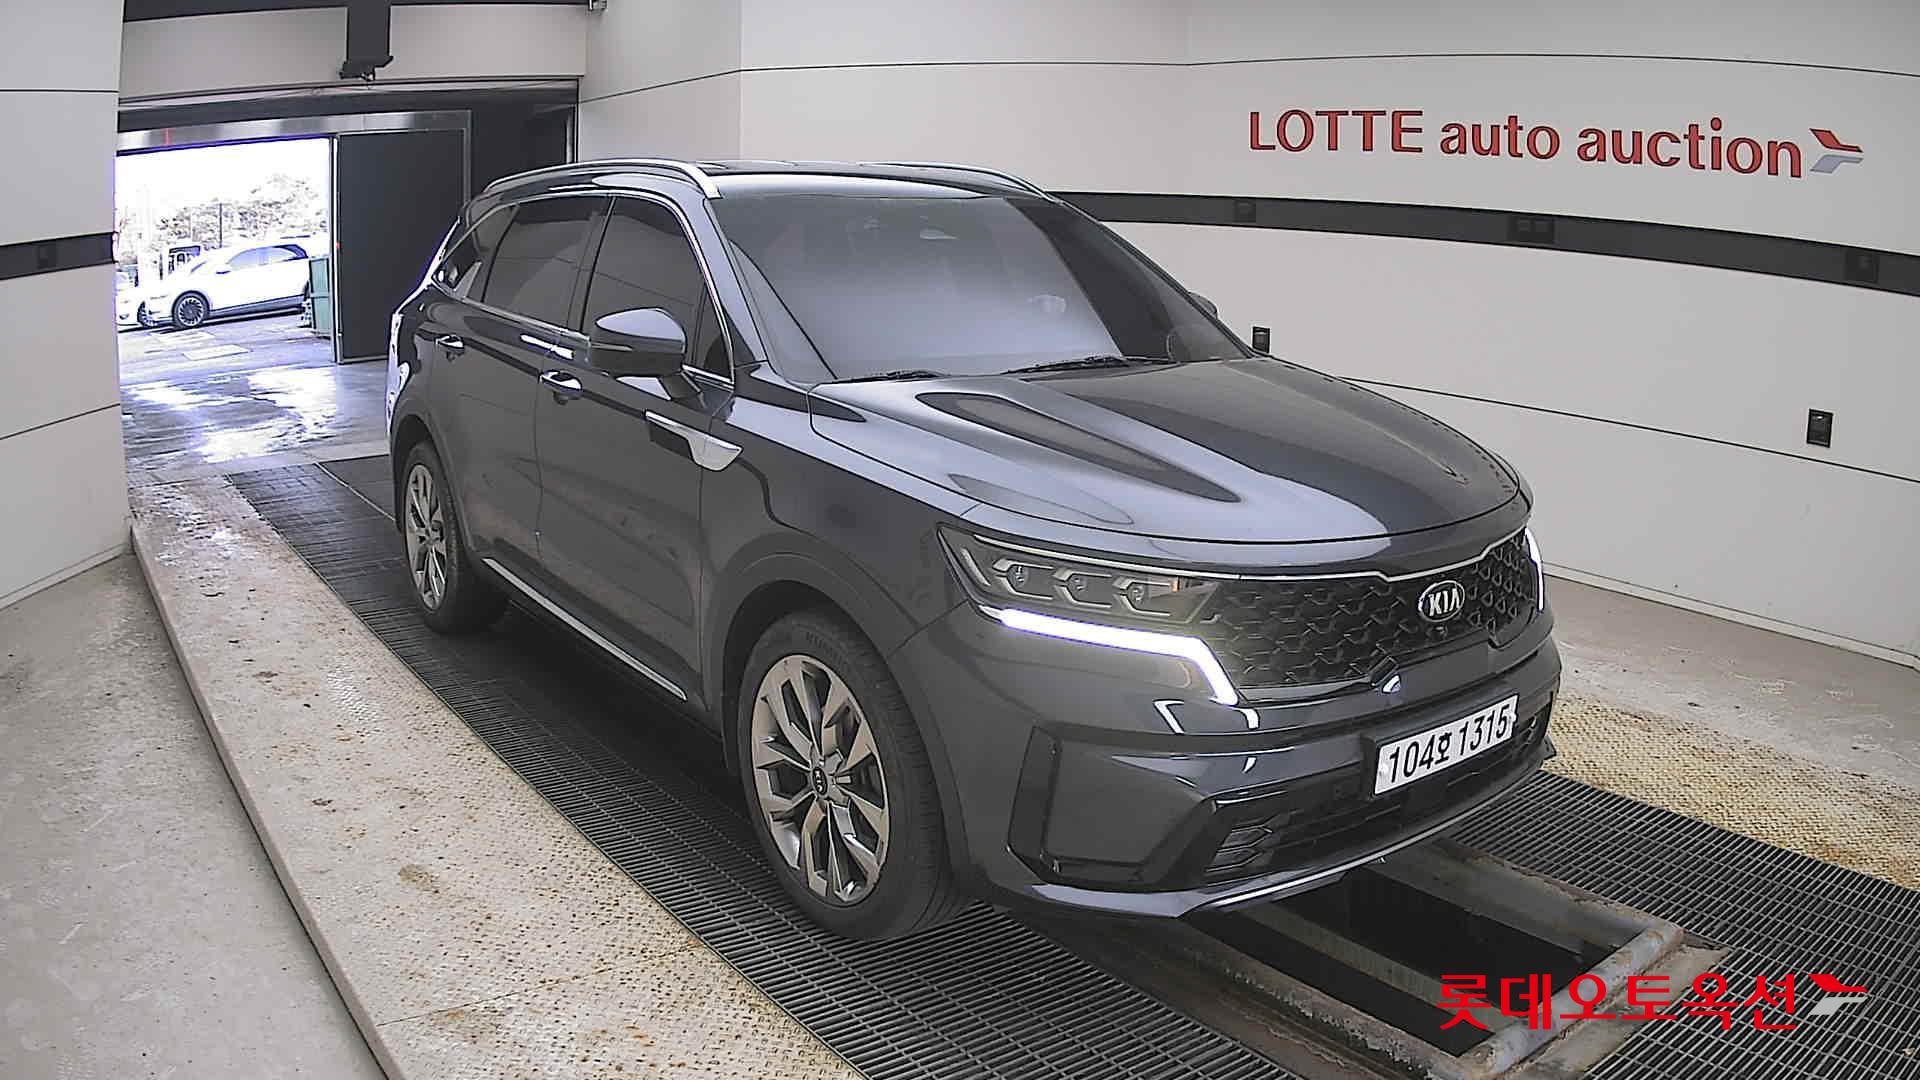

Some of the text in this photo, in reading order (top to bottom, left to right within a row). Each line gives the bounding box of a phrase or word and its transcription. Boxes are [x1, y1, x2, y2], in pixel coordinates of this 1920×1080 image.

[1249, 110, 1802, 178] LOTTE auto auction
[1428, 588, 1461, 616] KIA
[1459, 704, 1510, 755] 1315
